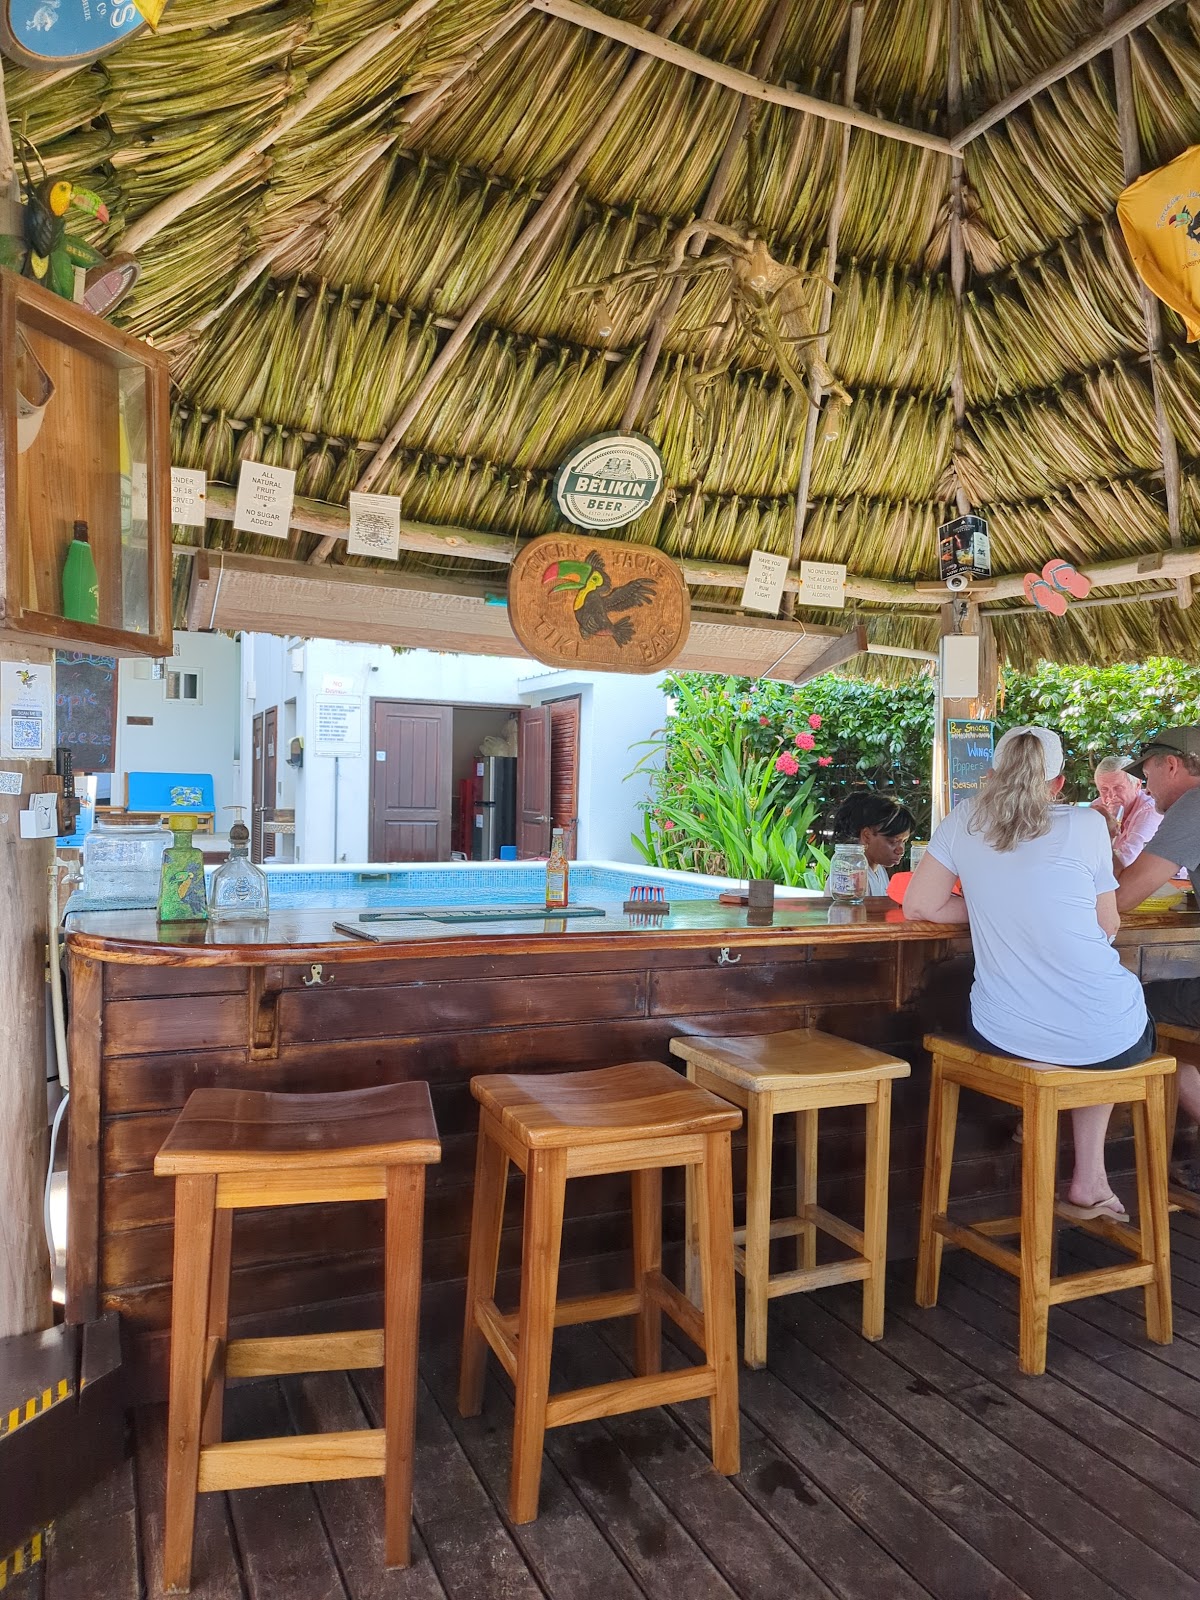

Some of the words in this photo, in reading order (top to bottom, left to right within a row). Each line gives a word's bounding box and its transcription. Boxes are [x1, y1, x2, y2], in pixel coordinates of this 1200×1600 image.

[261, 471, 275, 479] ALL
[251, 477, 282, 489] NATURAL
[575, 476, 646, 497] BELIKIN
[256, 486, 276, 495] FRUIT
[172, 496, 194, 505] ERVED
[253, 493, 277, 503] JUICES
[586, 498, 623, 512] BEER
[245, 508, 256, 516] NO
[256, 510, 280, 521] SUGAR
[250, 517, 274, 527] ADDED
[520, 542, 578, 581] TOUCAN
[758, 557, 771, 565] HAVE
[946, 567, 959, 577] NOW
[754, 591, 771, 599] FLIGHT
[534, 616, 580, 656] TIKI
[638, 626, 677, 661] BAR
[56, 688, 98, 721] opic
[950, 722, 962, 734] Bar
[964, 723, 989, 733] Snacks
[57, 729, 112, 746] reeze
[952, 757, 984, 776] Poppers
[952, 778, 978, 790] Season
